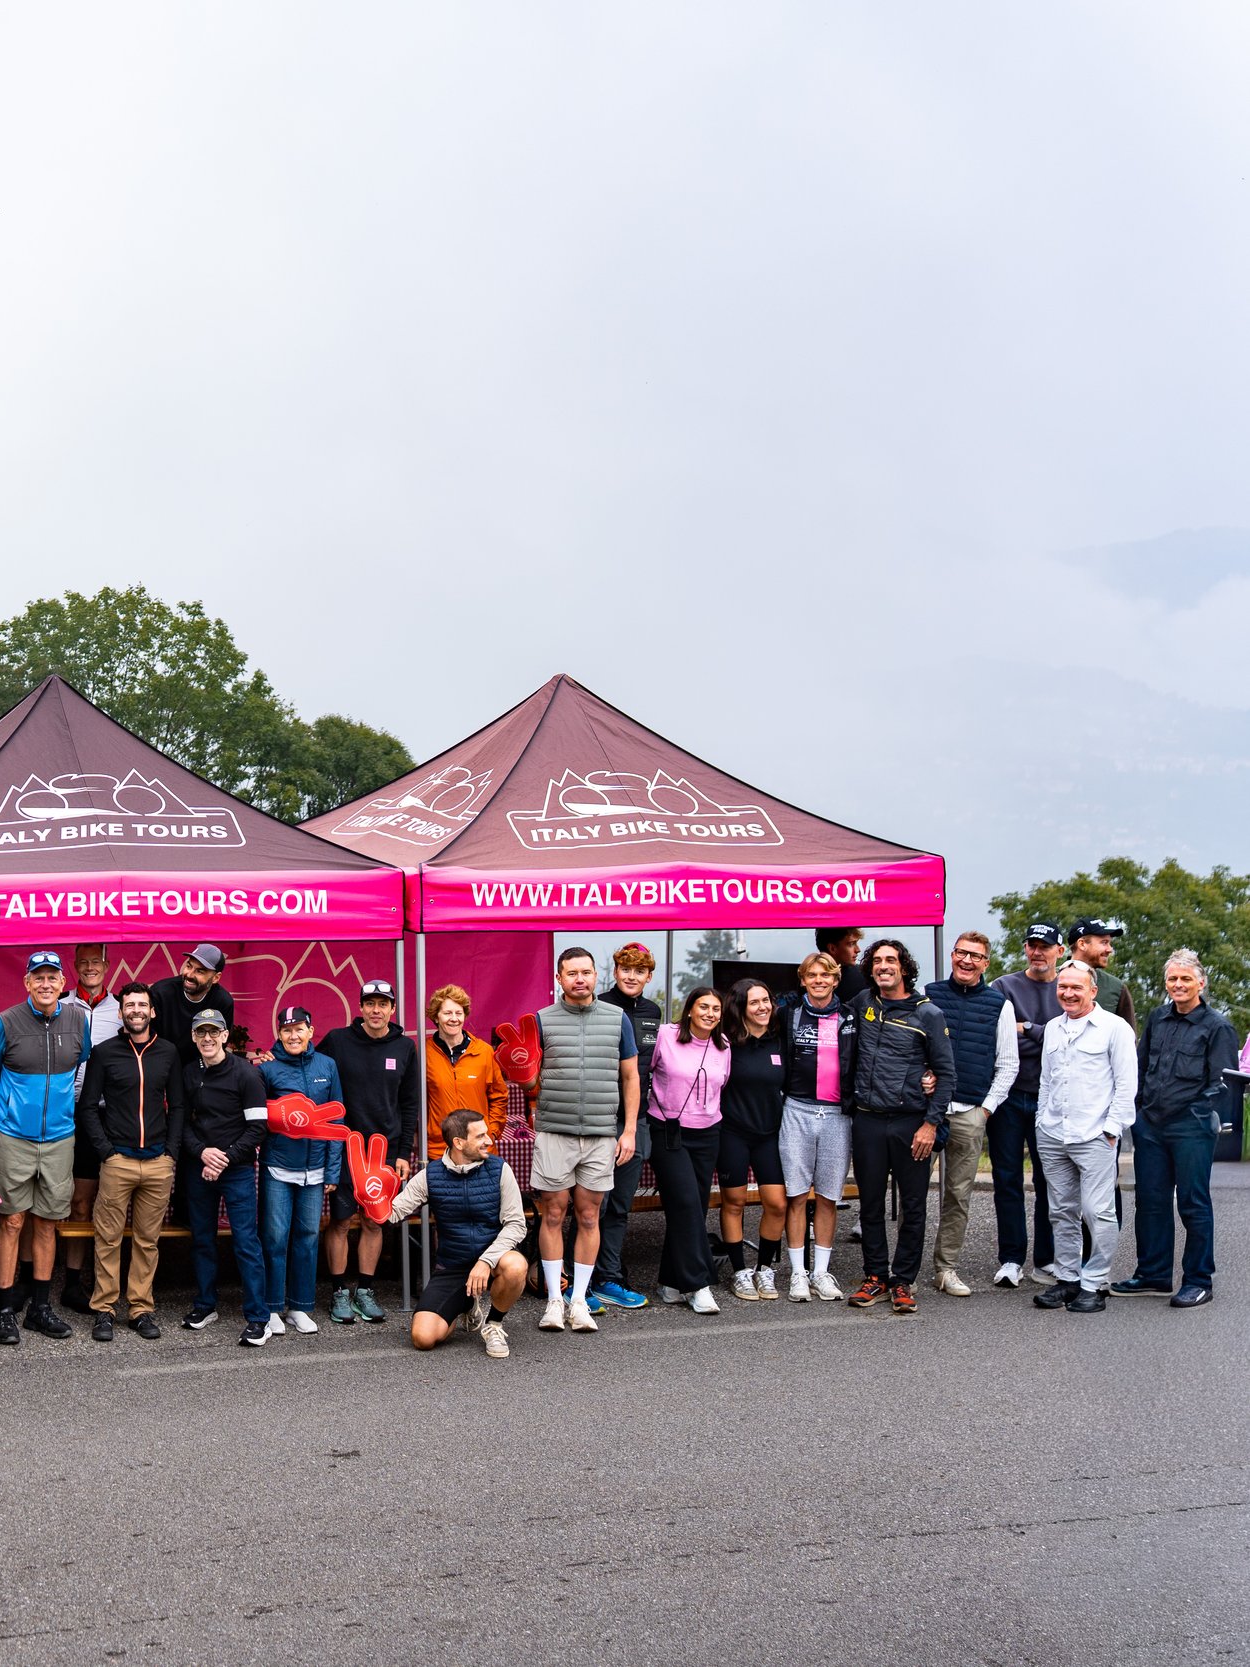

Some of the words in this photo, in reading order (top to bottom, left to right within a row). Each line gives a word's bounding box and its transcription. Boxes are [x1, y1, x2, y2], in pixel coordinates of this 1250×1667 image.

[60, 823, 124, 840] BIKE
[131, 823, 228, 839] TOURS
[530, 824, 601, 842] ITALY
[611, 820, 671, 836] BIKE
[673, 822, 766, 838] TOURS
[471, 878, 877, 908] WWW.ITALYBIKETOURS.COM
